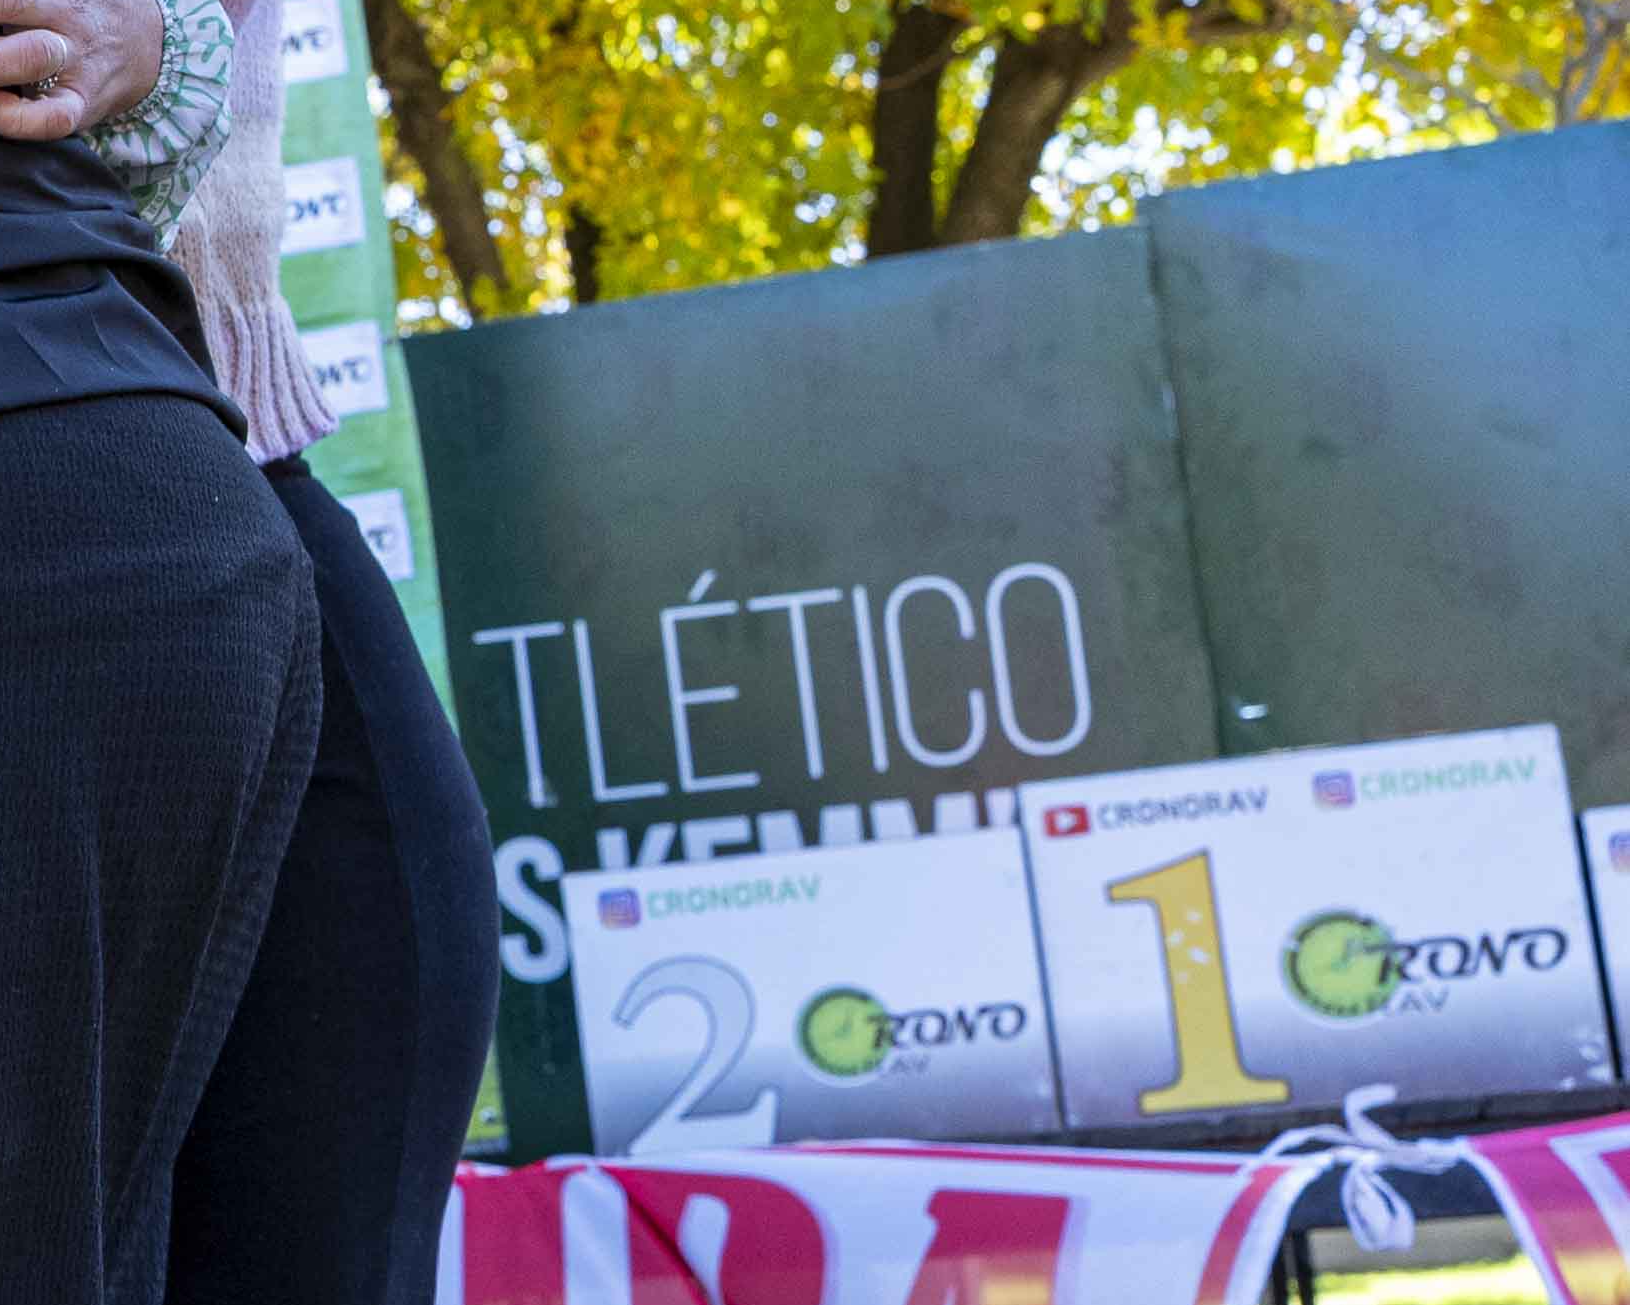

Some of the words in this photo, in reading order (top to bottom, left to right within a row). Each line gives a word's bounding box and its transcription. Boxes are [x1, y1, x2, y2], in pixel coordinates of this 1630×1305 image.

[1360, 755, 1537, 800] CRONORAV
[1096, 786, 1270, 831] CRONORAV
[644, 873, 822, 920] CRONORAV
[1105, 848, 1291, 1116] 1
[611, 953, 780, 1157] 2
